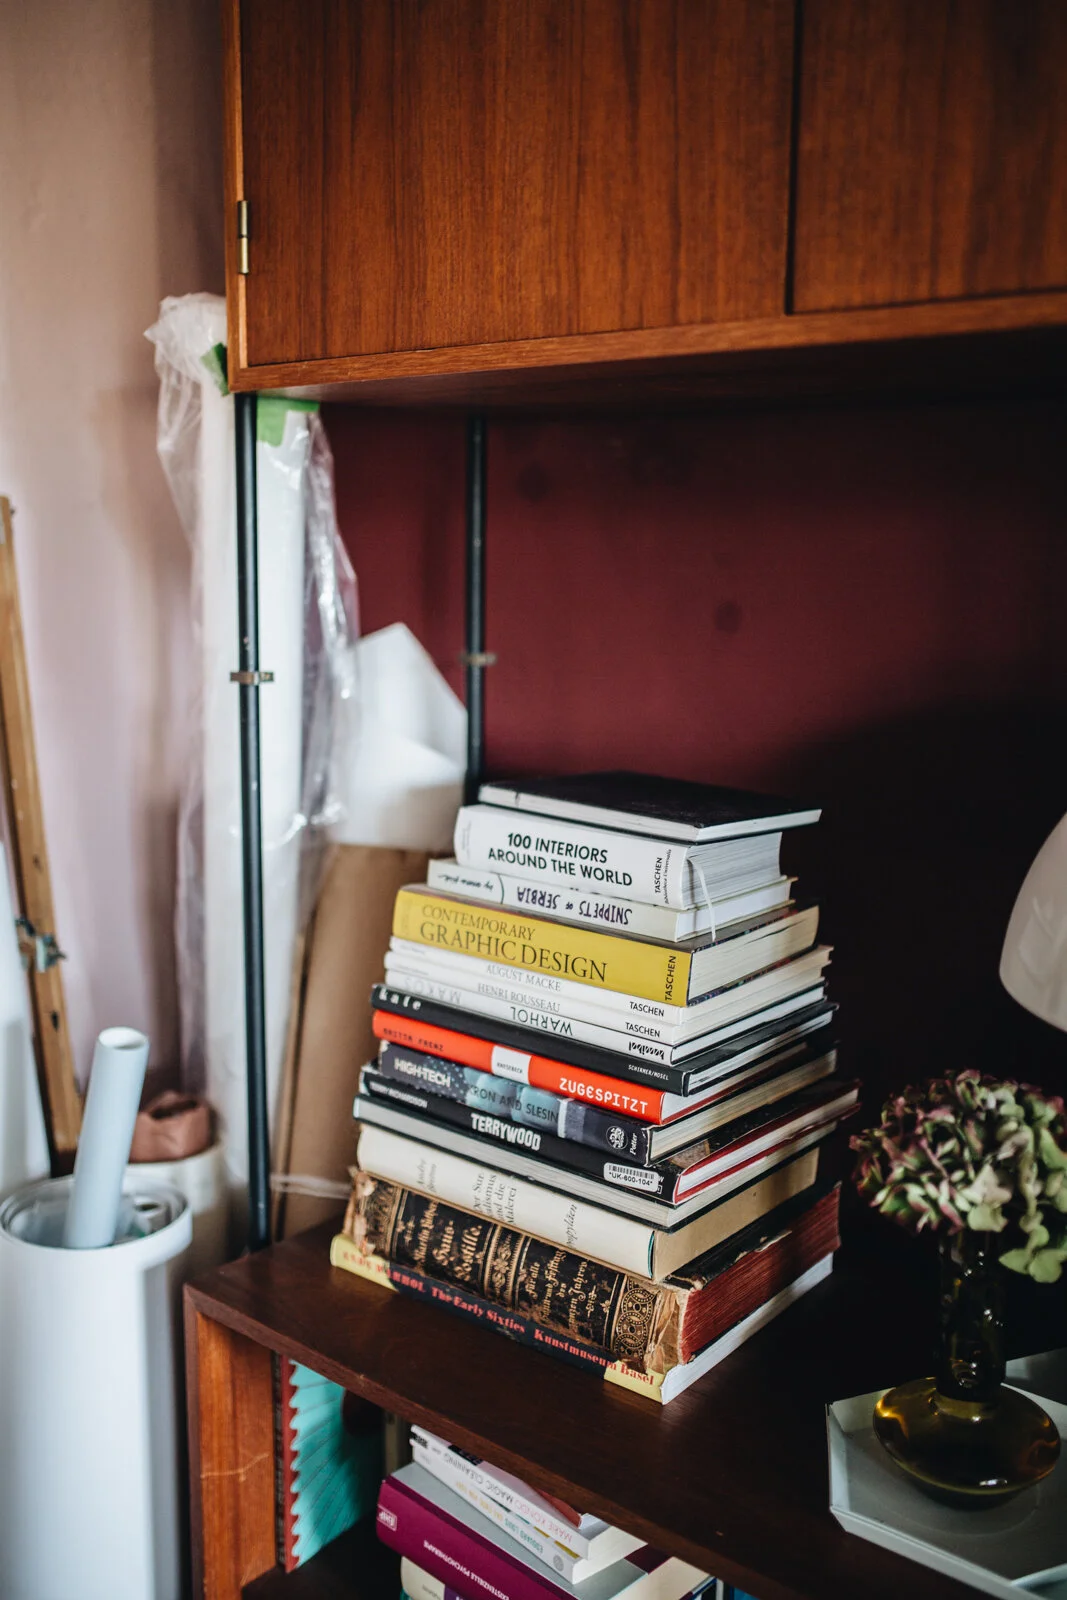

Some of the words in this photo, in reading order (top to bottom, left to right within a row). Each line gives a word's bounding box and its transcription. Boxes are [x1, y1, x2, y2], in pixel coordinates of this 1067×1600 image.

[508, 833, 532, 849] 100
[535, 837, 608, 863] INTERIORS
[488, 848, 547, 869] AROUND
[551, 859, 576, 876] THE
[580, 864, 633, 886] WORLD
[654, 857, 662, 893] TASCHEN
[517, 886, 561, 910] SERBIA
[421, 905, 536, 941] CONTEMPORARY
[579, 901, 633, 925] SNIPPETS
[420, 921, 517, 961] GRAPHIC
[521, 943, 608, 982] DESIGN
[405, 977, 461, 1005] MAKOS
[486, 964, 524, 982] AUGUST
[525, 974, 561, 991] MACKE
[665, 956, 676, 1001] TASCHEN
[379, 988, 421, 1010] kate
[478, 983, 508, 1000] HENRI
[510, 991, 561, 1012] ROUSSEAU
[630, 1001, 664, 1017] TASCHEN
[510, 1006, 573, 1036] WARHOL
[625, 1022, 660, 1038] TASCHEN
[383, 1028, 413, 1041] BRITTA
[418, 1038, 444, 1052] FRENZ
[393, 1058, 451, 1088] HIGH-TECH
[369, 1081, 389, 1095] TERRY
[559, 1077, 649, 1115] ZUGESPITZT
[469, 1085, 496, 1102] KRON
[500, 1094, 523, 1111] AND
[526, 1103, 559, 1122] SLESIN
[470, 1113, 542, 1151] TERRYWOOD
[629, 1133, 638, 1155] Potter
[498, 1183, 506, 1199] die
[530, 1262, 540, 1278] alle
[556, 1283, 567, 1298] des
[375, 1263, 426, 1293] WARHOL
[431, 1286, 453, 1302] The
[453, 1296, 484, 1317] Early
[486, 1309, 526, 1334] Sixties
[533, 1328, 618, 1371] Kunstmuseum
[620, 1363, 655, 1385] Basel
[444, 1453, 483, 1485] CLEANING
[485, 1480, 513, 1503] MAGIC
[514, 1502, 546, 1524] KONDO
[549, 1521, 573, 1543] MARIE
